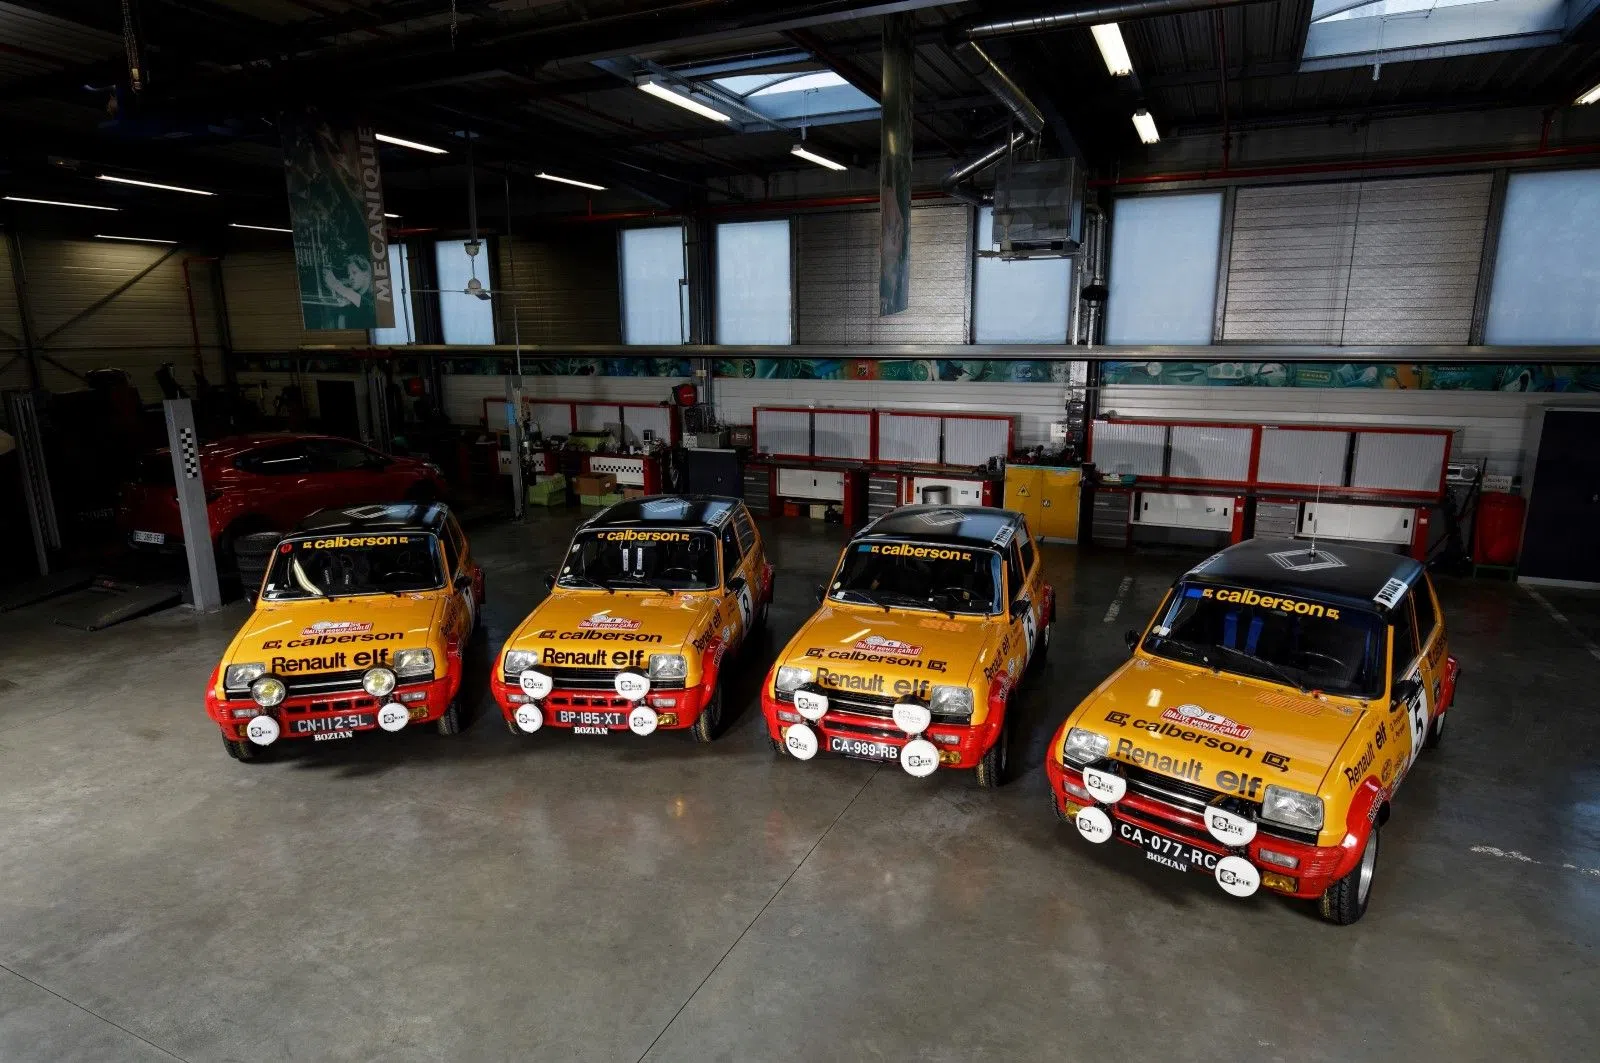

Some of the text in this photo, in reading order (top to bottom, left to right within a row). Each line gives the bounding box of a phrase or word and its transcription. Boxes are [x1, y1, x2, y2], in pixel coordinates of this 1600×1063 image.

[357, 125, 390, 302] MECANIQUE
[314, 536, 397, 549] calberson
[606, 530, 680, 541] calberson
[881, 544, 960, 560] calberson
[1215, 588, 1325, 617] calberson
[286, 632, 404, 648] calberson
[559, 630, 663, 643] calberson
[692, 621, 714, 656] Renault
[712, 608, 721, 629] elf
[271, 648, 389, 674] Renault elf
[543, 648, 644, 666] Renault elf
[827, 649, 923, 668] calberson
[983, 648, 1003, 686] Renault
[815, 667, 930, 698] Renault elf
[297, 714, 368, 733] CN-112-SL
[559, 711, 621, 725] BP-185-XT
[1163, 708, 1190, 726] RALLYE
[313, 730, 353, 741] BOZIAN
[574, 726, 608, 735] BOZIAN
[1132, 719, 1254, 759] calberson
[832, 738, 898, 759] CA-989-RB
[1343, 720, 1388, 791] Renault elf
[1115, 737, 1263, 798] Renault elf
[1120, 823, 1217, 870] CA-077-RC
[1146, 850, 1187, 873] BOZIAN
